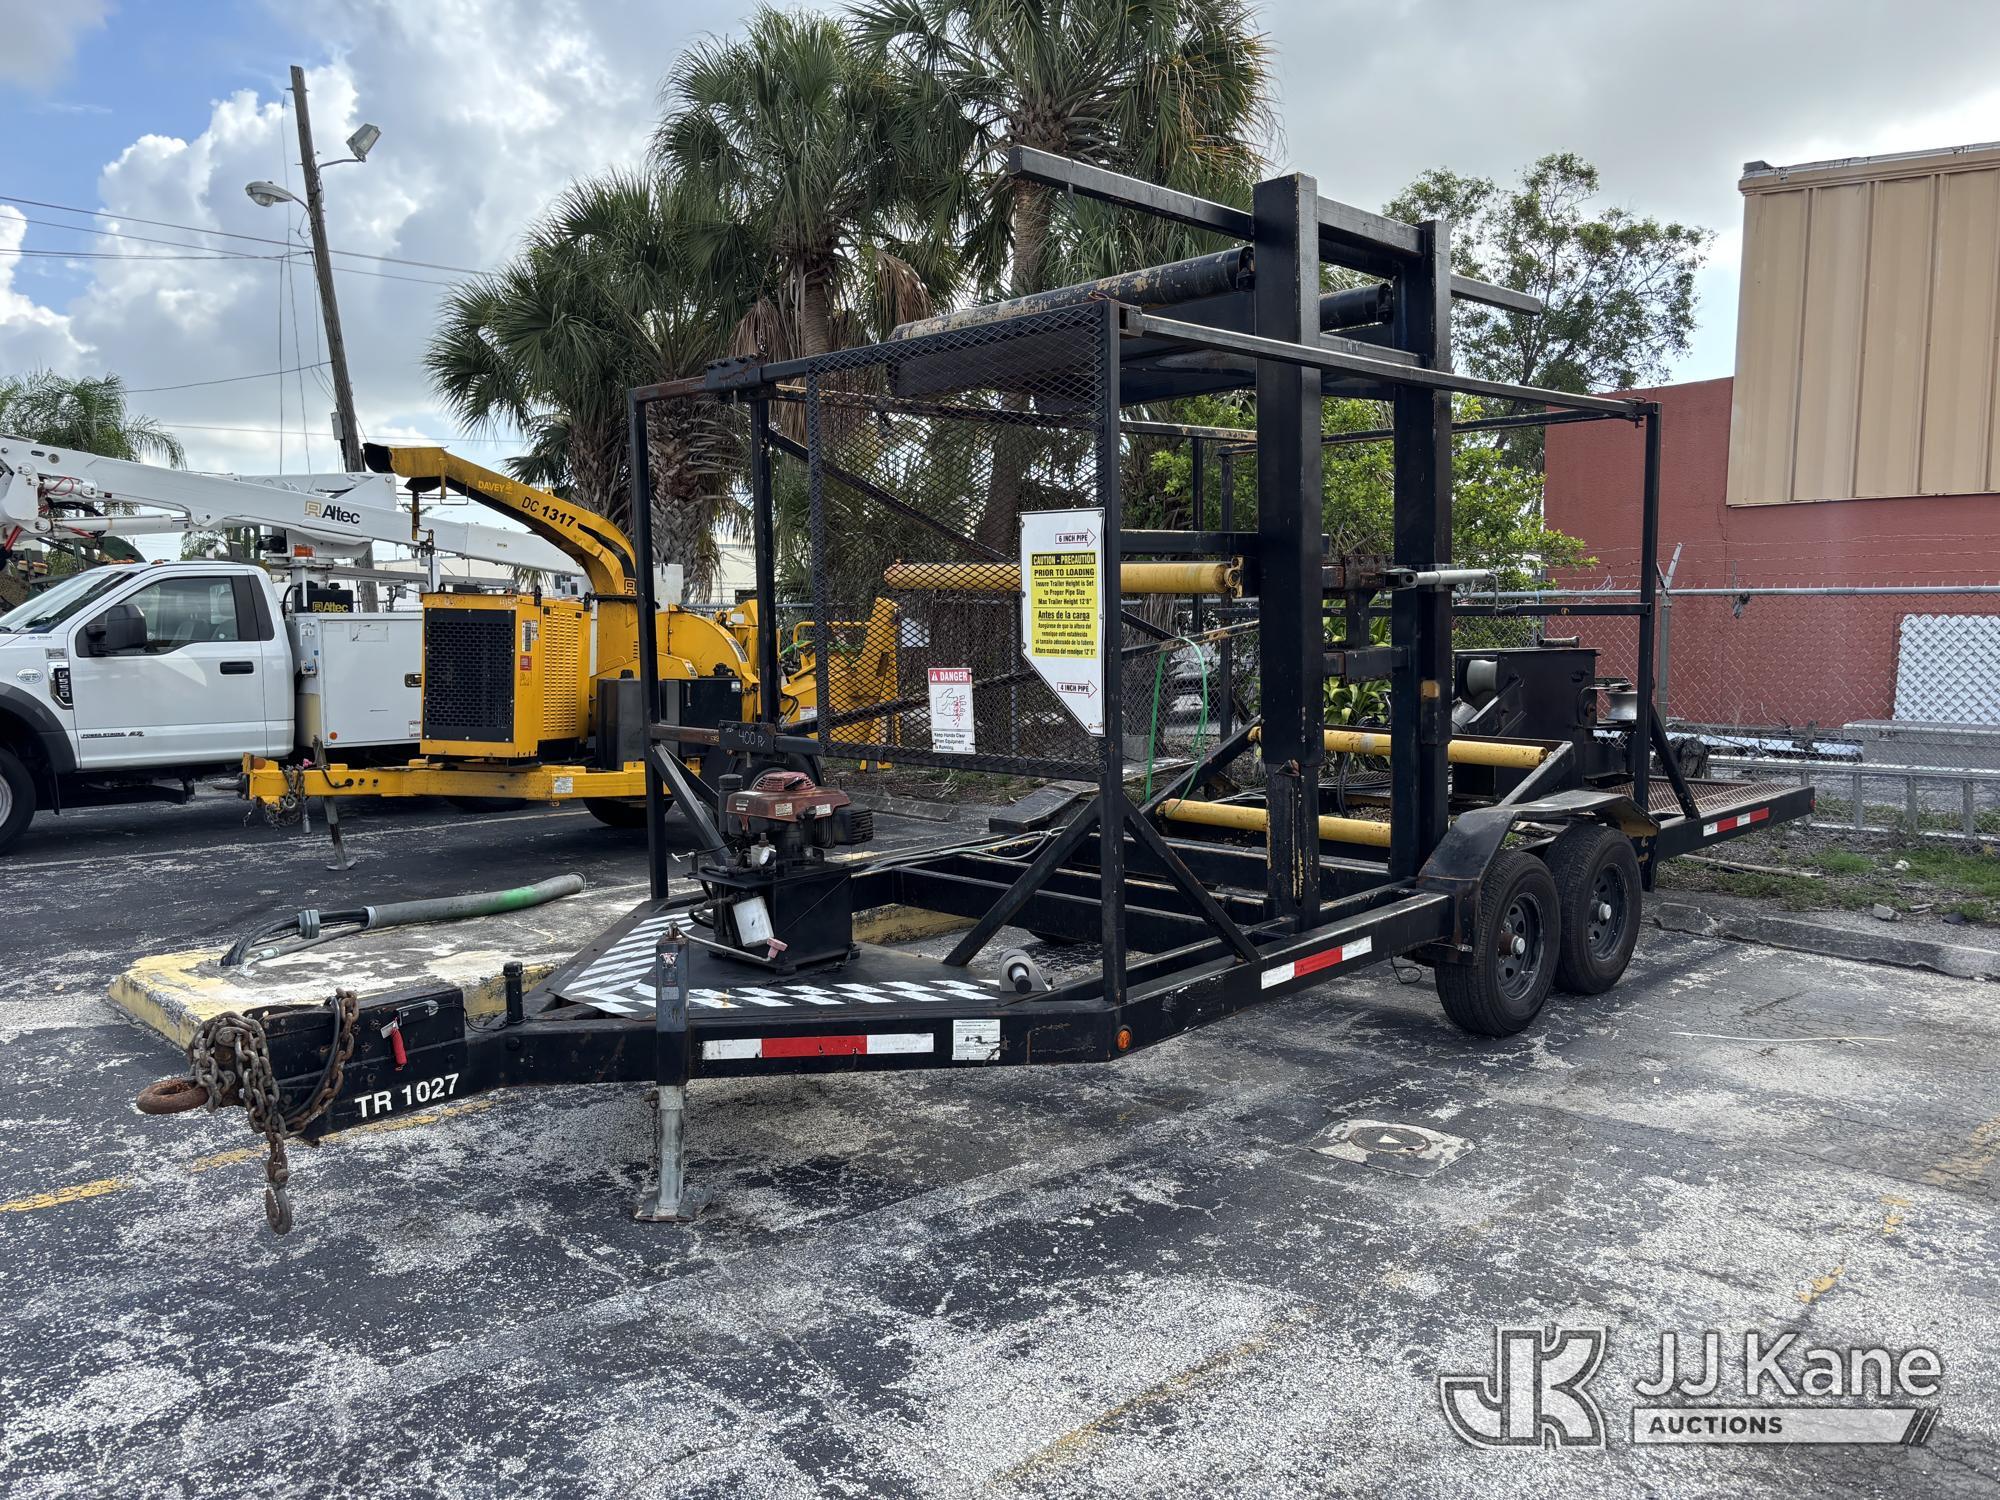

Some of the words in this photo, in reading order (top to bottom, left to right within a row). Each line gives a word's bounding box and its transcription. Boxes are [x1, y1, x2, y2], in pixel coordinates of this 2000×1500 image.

[478, 481, 505, 492] DAVEY
[321, 504, 361, 525] Altec
[522, 496, 540, 512] DC
[542, 505, 576, 527] 1317
[1033, 555, 1056, 565] CAUTION
[1066, 568, 1095, 576] LOADING
[1065, 580, 1080, 588] Height
[1050, 589, 1064, 597] Proper
[1065, 589, 1076, 597] Pipe
[1063, 598, 1078, 606] Height
[323, 602, 349, 613] Altec
[1038, 611, 1055, 619] Antes
[1056, 611, 1064, 619] de
[1064, 611, 1071, 619] la
[1073, 612, 1090, 620] carga
[940, 671, 968, 682] DANGER
[354, 1090, 393, 1118] TR
[401, 1072, 460, 1106] 1027
